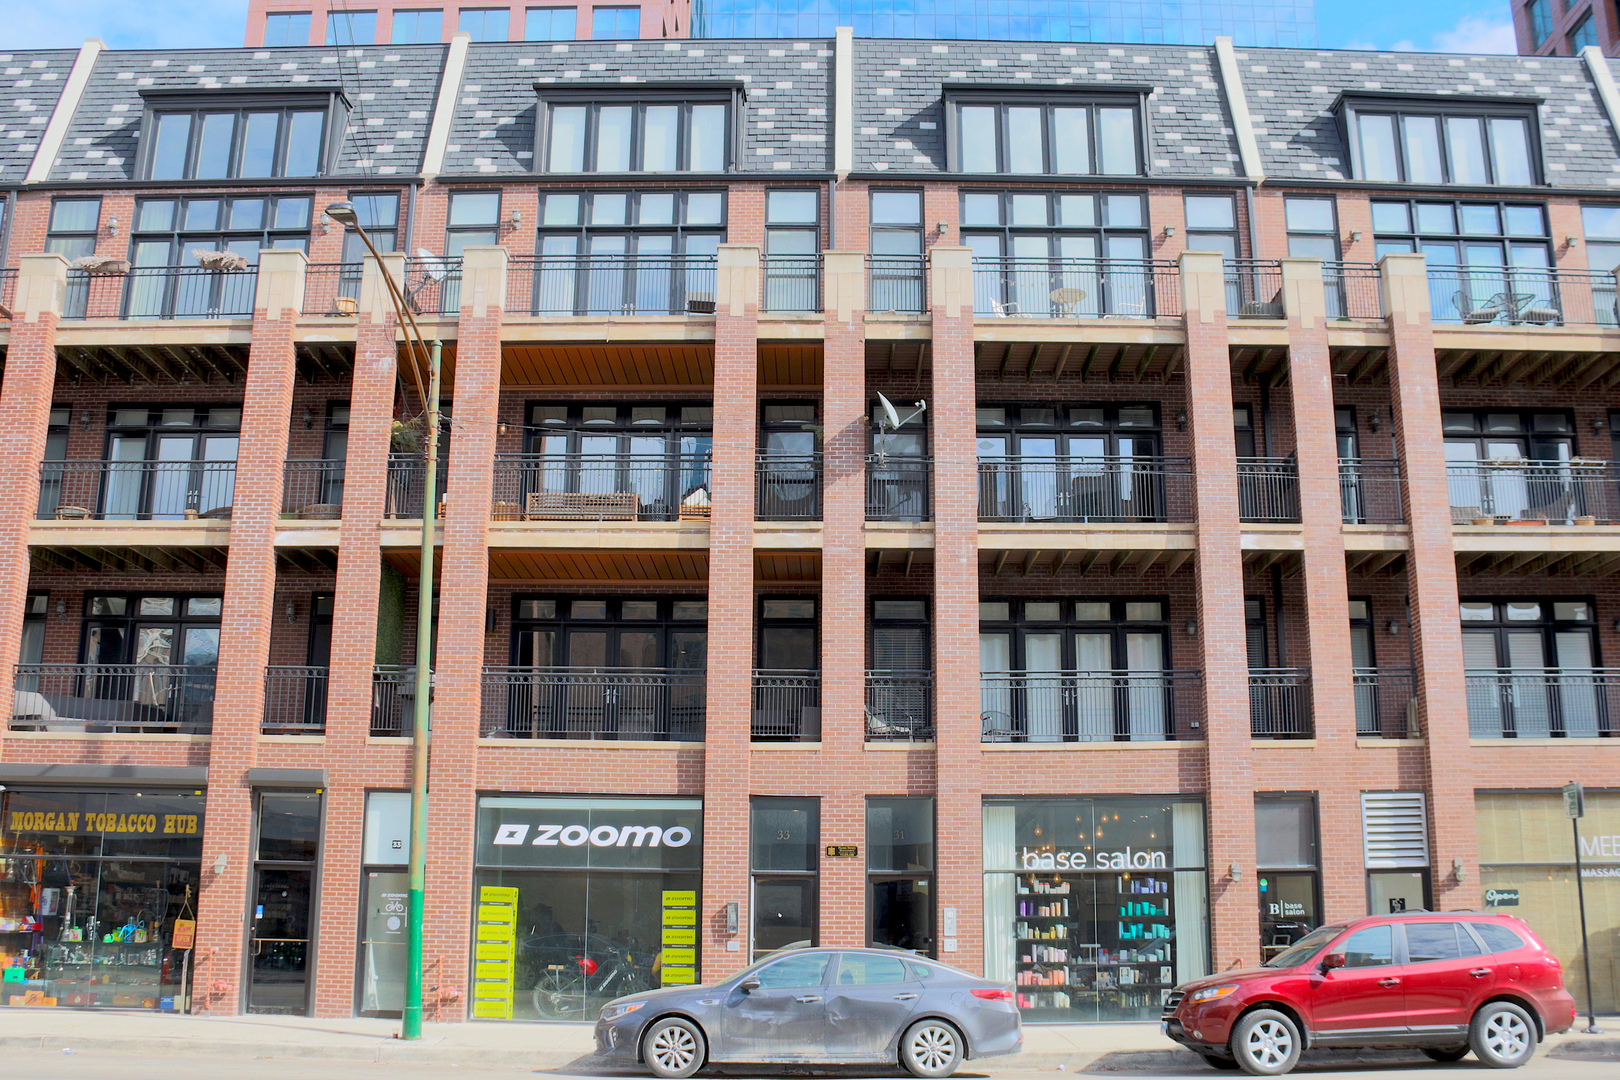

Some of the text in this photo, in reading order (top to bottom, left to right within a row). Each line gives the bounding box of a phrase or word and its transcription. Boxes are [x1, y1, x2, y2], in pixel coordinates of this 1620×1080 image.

[10, 811, 198, 834] MORGAN TOBACCO HUB
[532, 824, 692, 848] zoomo
[777, 830, 791, 840] 33
[893, 830, 905, 840] 31
[1023, 845, 1166, 870] base salon
[1486, 889, 1519, 907] Open
[1269, 903, 1280, 915] B
[1284, 908, 1306, 916] salon
[176, 935, 191, 943] OPEN
